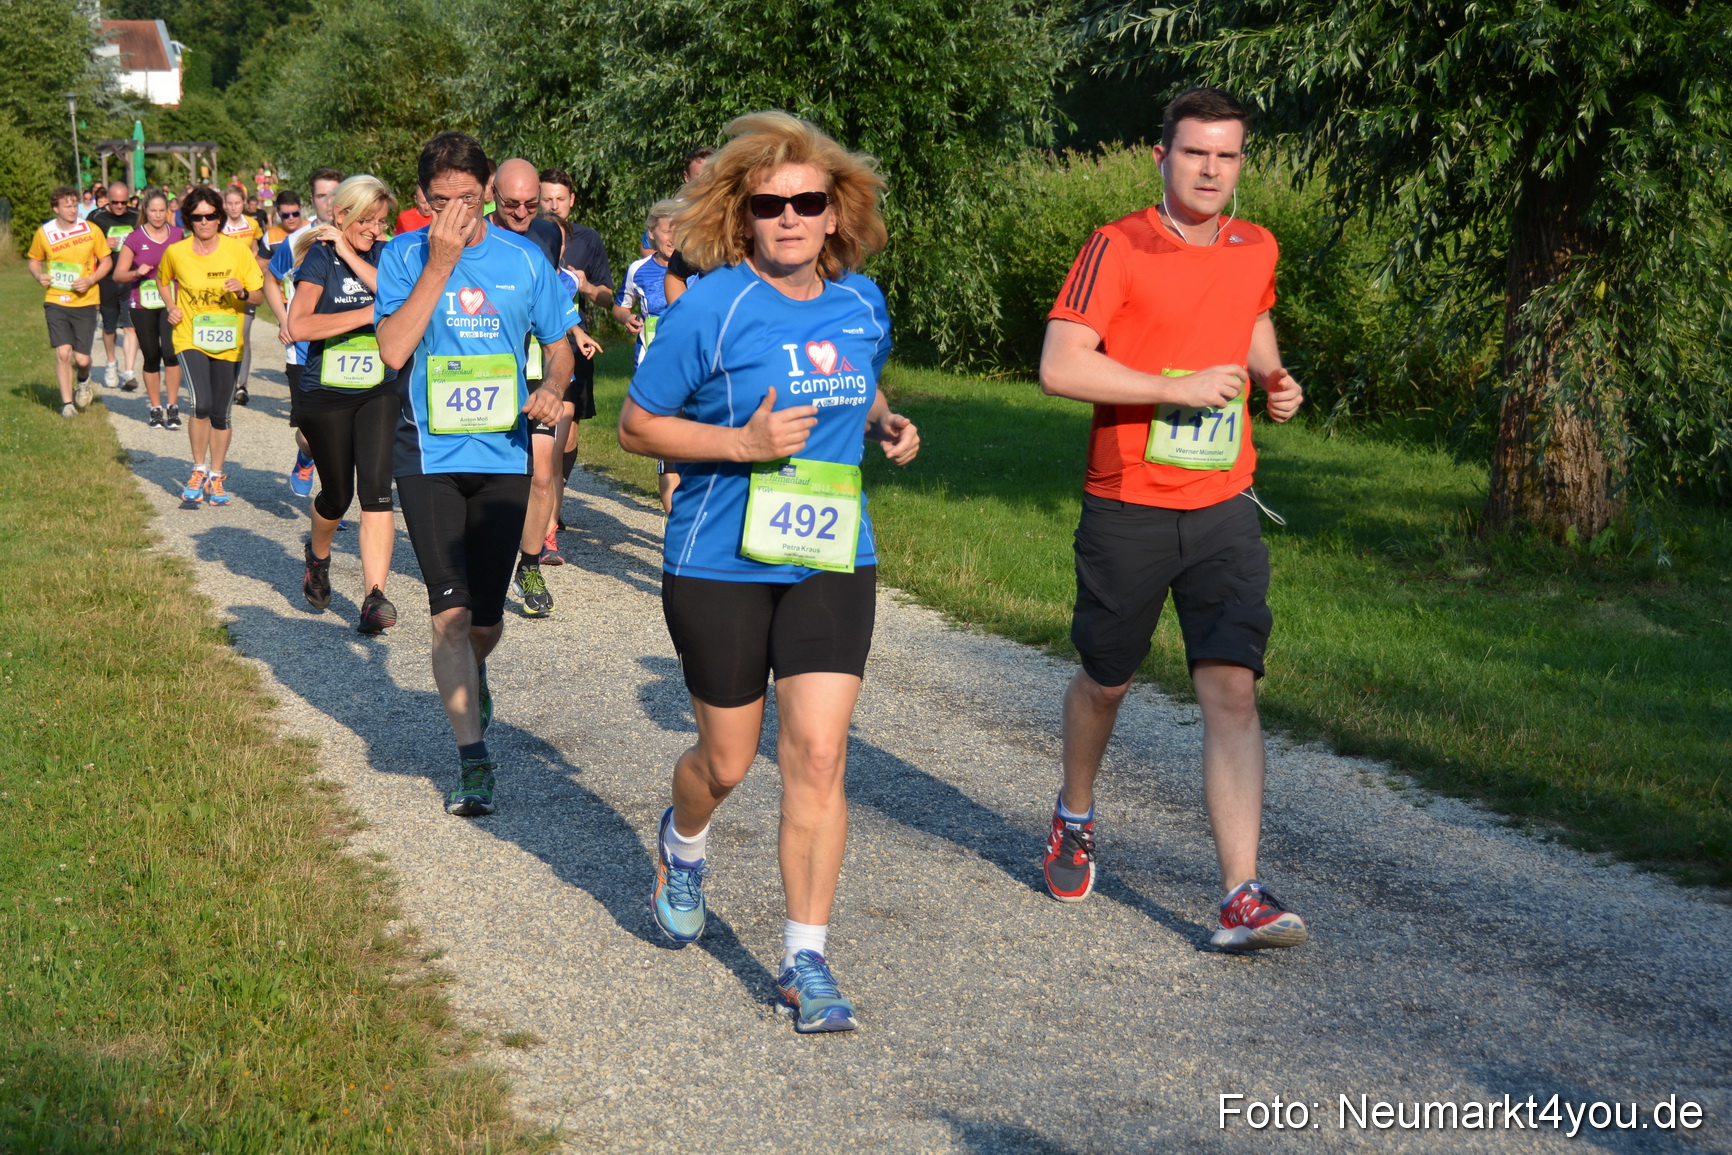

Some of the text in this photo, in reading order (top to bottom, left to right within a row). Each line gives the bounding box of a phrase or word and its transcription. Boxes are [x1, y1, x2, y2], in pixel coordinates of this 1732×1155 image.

[52, 236, 94, 253] MAX BÖGL
[55, 272, 74, 283] 910
[334, 295, 358, 304] Weil's
[445, 292, 457, 315] I
[446, 315, 500, 331] camping
[198, 329, 233, 343] 1528
[479, 331, 499, 339] Berger
[337, 355, 373, 373] 175
[782, 344, 804, 377] I
[790, 372, 866, 396] camping
[446, 386, 500, 412] 487
[839, 396, 867, 407] Berger
[1165, 409, 1235, 443] 1171
[1175, 447, 1199, 455] Werner
[770, 474, 811, 486] firmenlauf
[769, 501, 838, 541] 492
[782, 543, 820, 553] Petra Kraus
